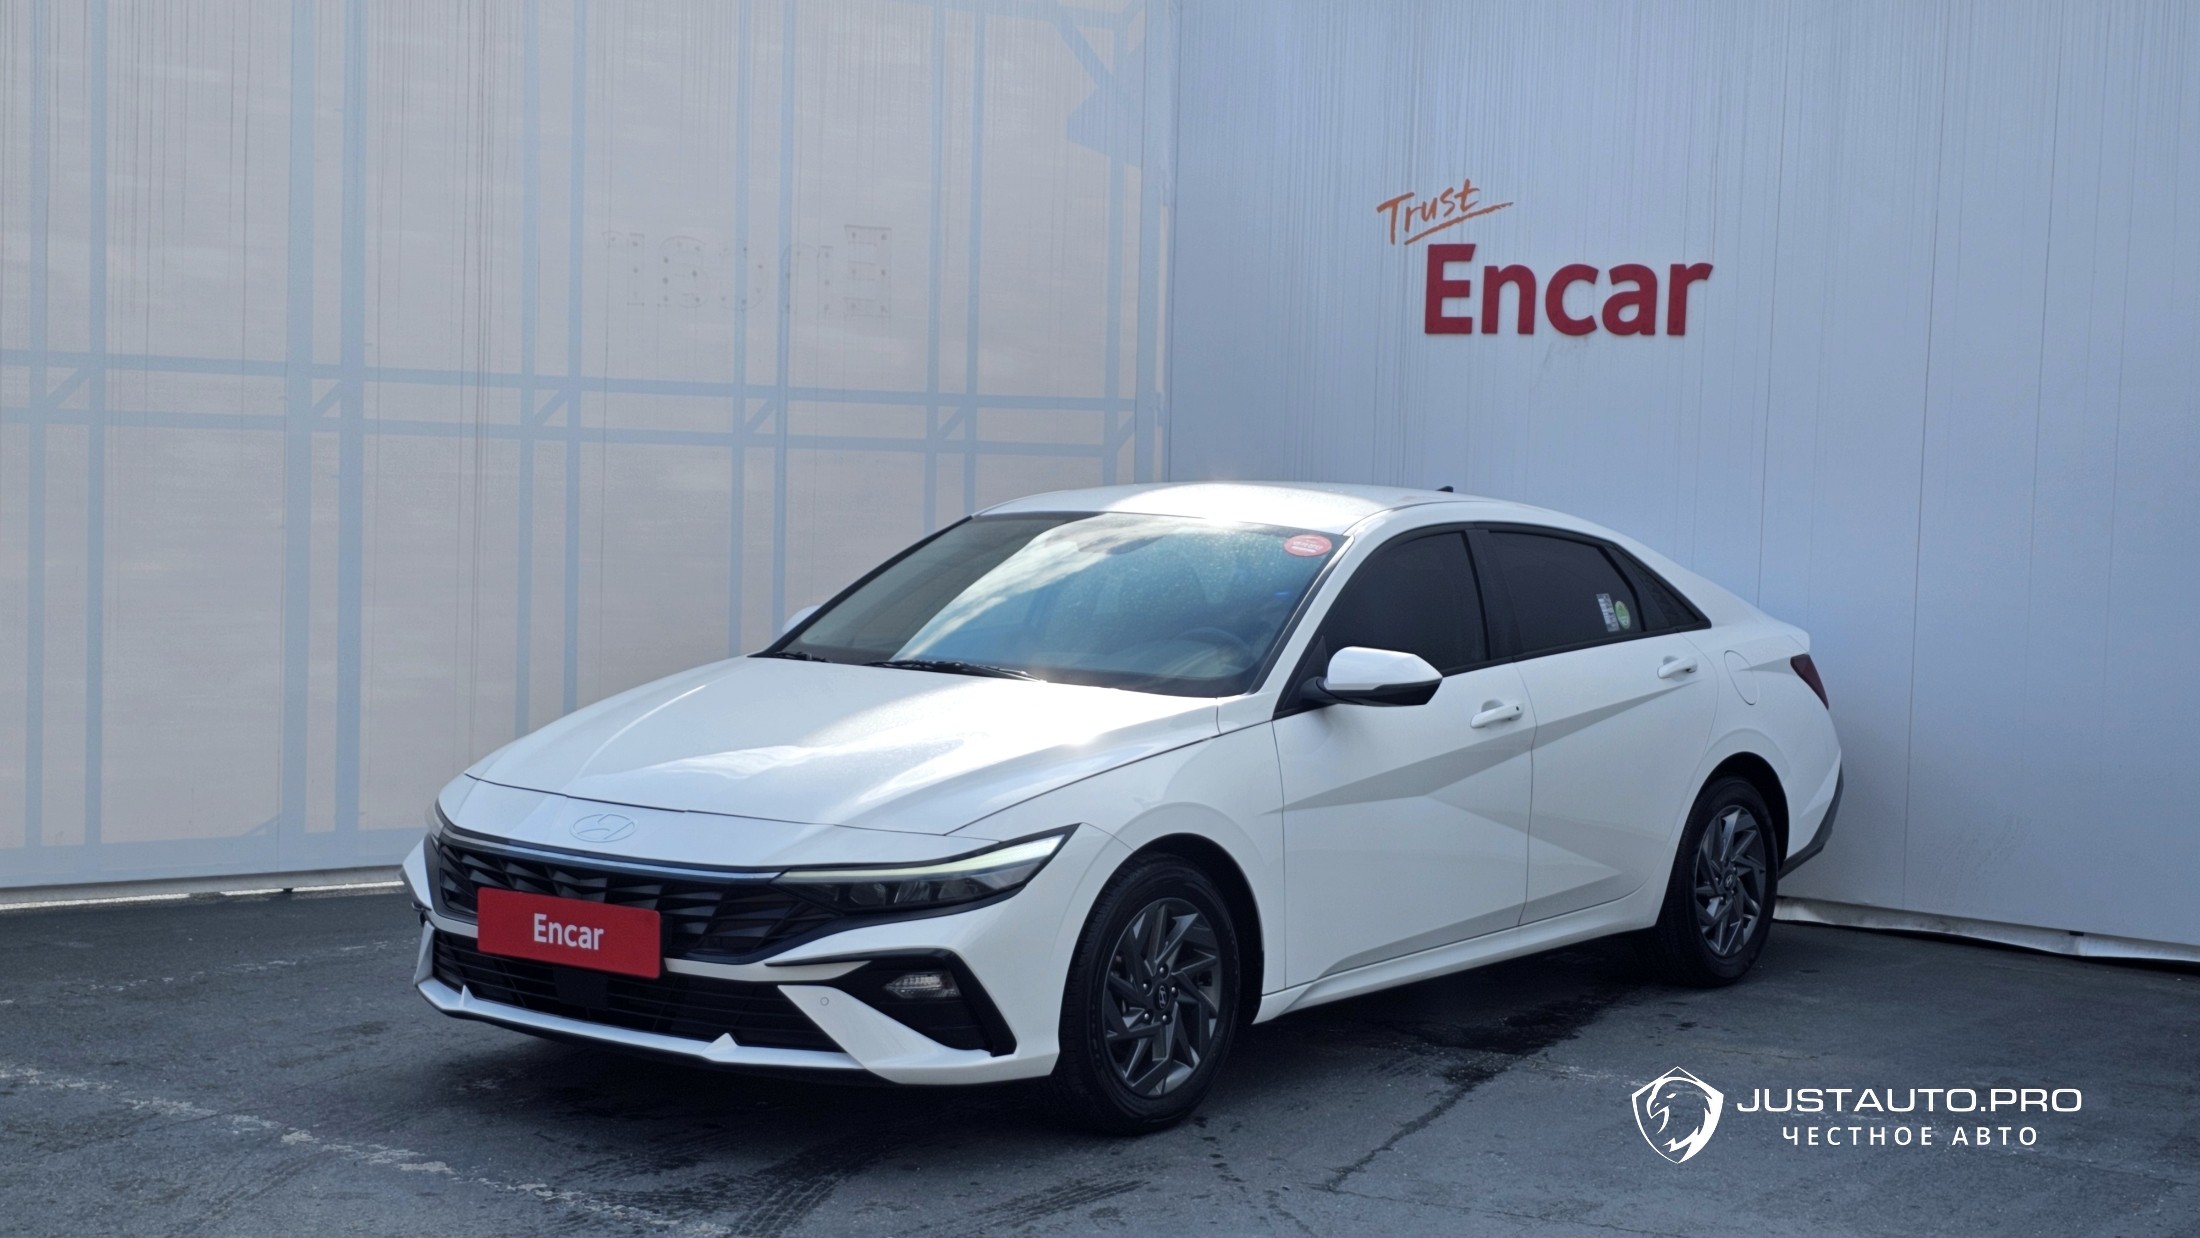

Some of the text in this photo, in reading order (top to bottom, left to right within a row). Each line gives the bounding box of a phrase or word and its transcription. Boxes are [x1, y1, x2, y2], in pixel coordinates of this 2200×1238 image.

[1376, 179, 1480, 244] Trust
[1424, 243, 1713, 336] Encar
[533, 913, 604, 951] Encar
